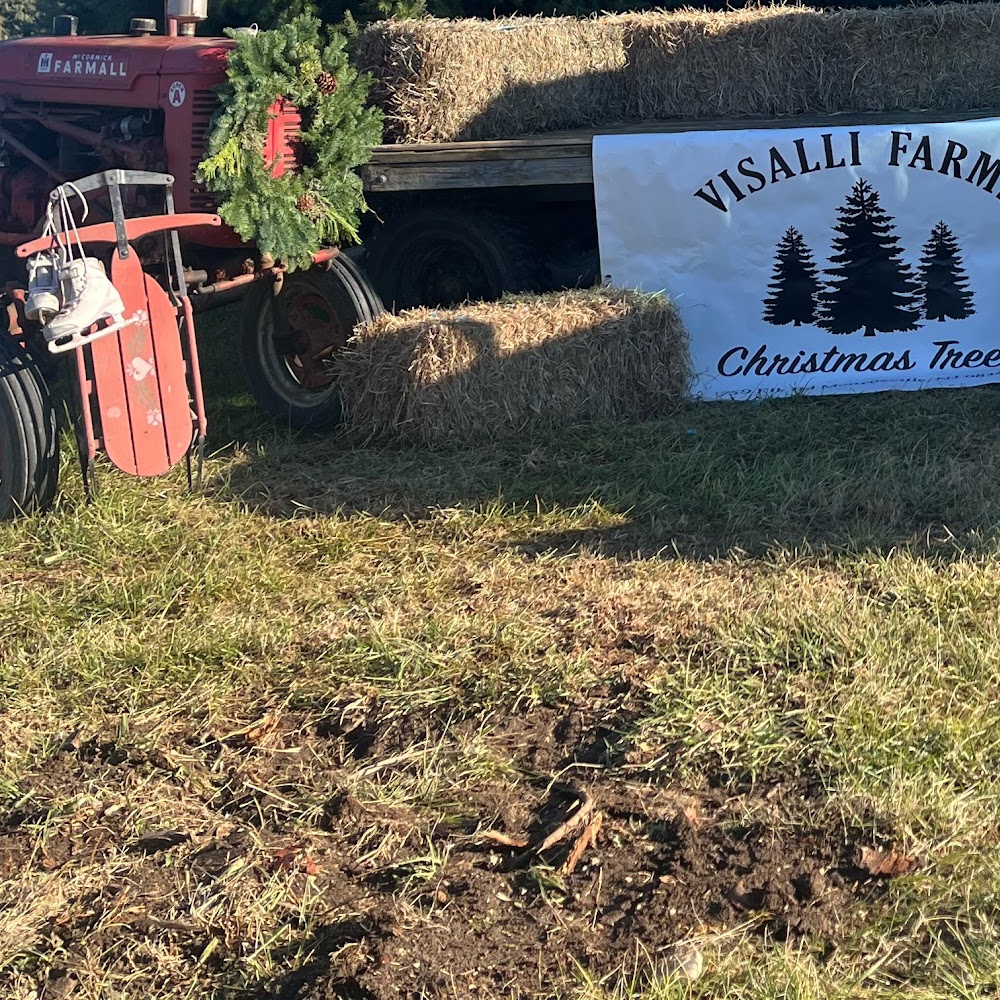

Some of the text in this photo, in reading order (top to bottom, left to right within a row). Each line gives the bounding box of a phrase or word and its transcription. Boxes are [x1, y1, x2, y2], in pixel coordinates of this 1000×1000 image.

[54, 60, 127, 76] FARMALL
[172, 89, 181, 104] A
[694, 131, 861, 213] VISALLI
[717, 344, 916, 377] Christmas
